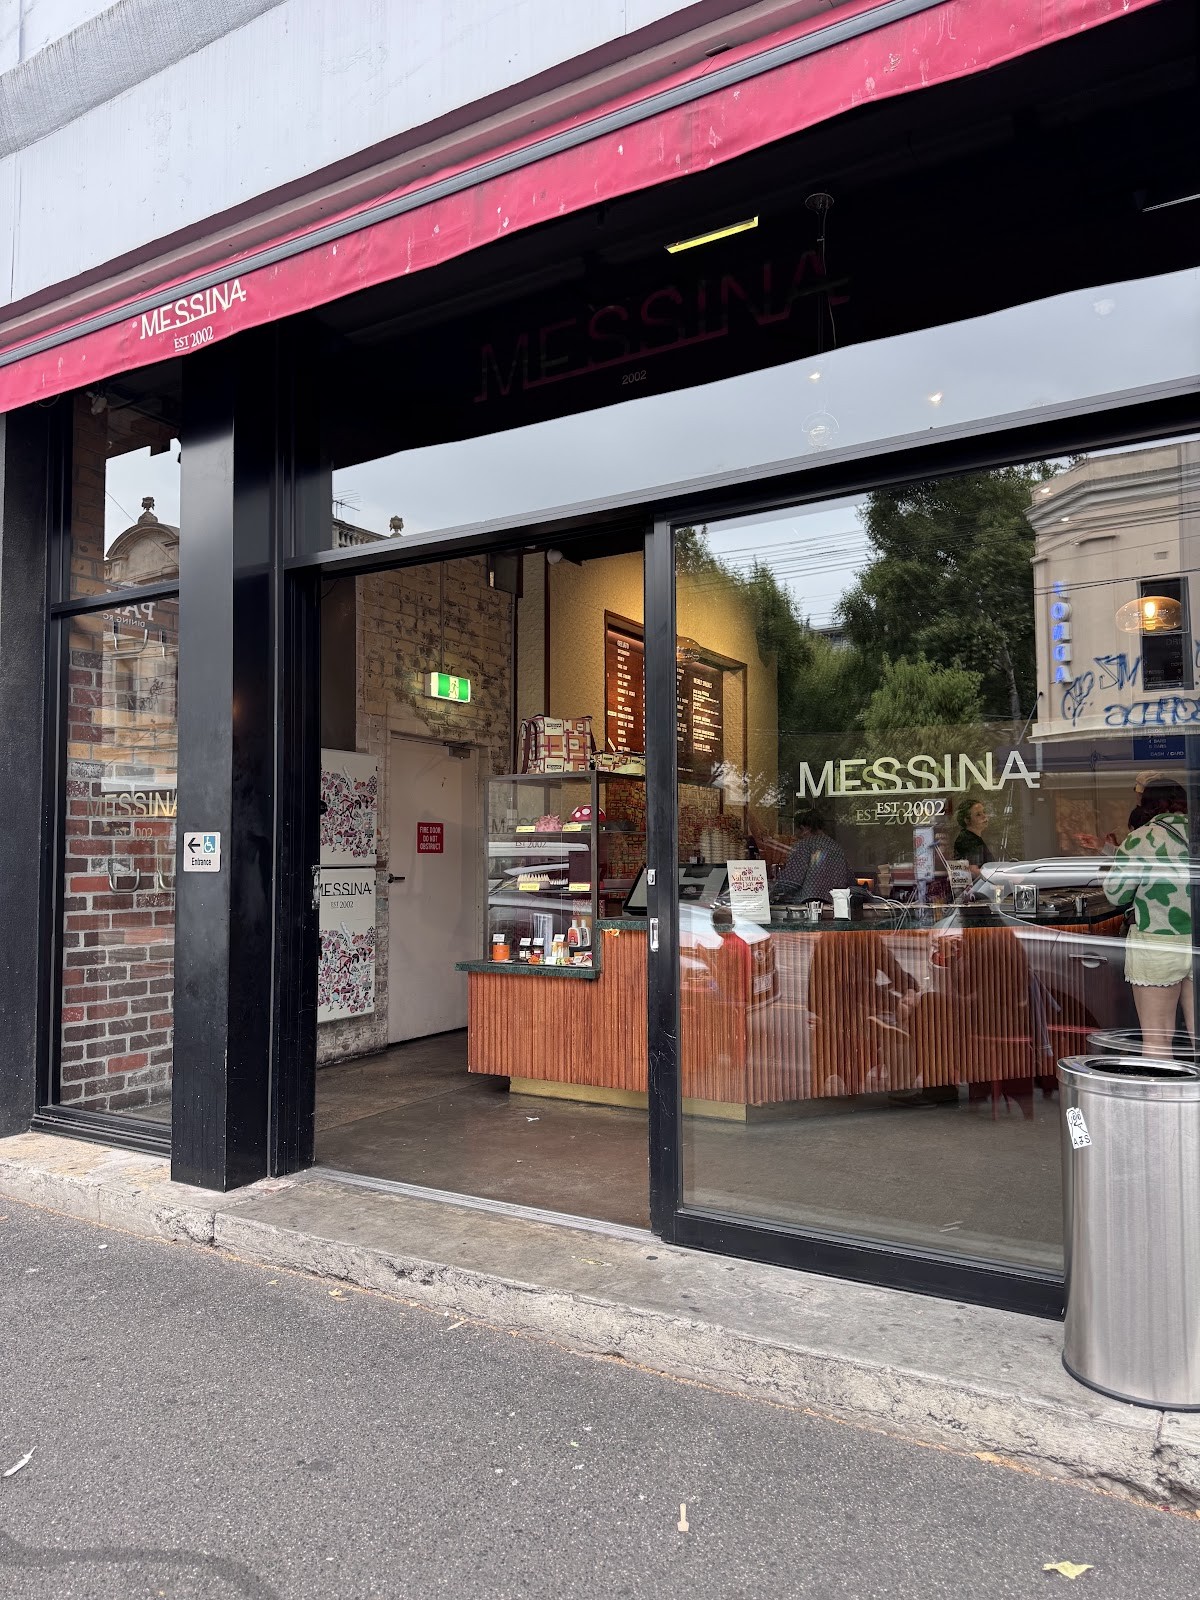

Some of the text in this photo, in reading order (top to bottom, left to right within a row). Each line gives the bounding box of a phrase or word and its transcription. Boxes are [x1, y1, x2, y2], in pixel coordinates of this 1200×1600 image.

[140, 278, 246, 340] MESSINA
[473, 249, 851, 403] MESSINA
[174, 325, 214, 352] EST 2002
[621, 369, 647, 385] 2002
[796, 750, 1041, 798] MESSINA
[876, 800, 946, 817] EST 2002
[430, 826, 441, 834] DOOR
[191, 857, 212, 866] Entrance
[340, 901, 354, 909] 2002
